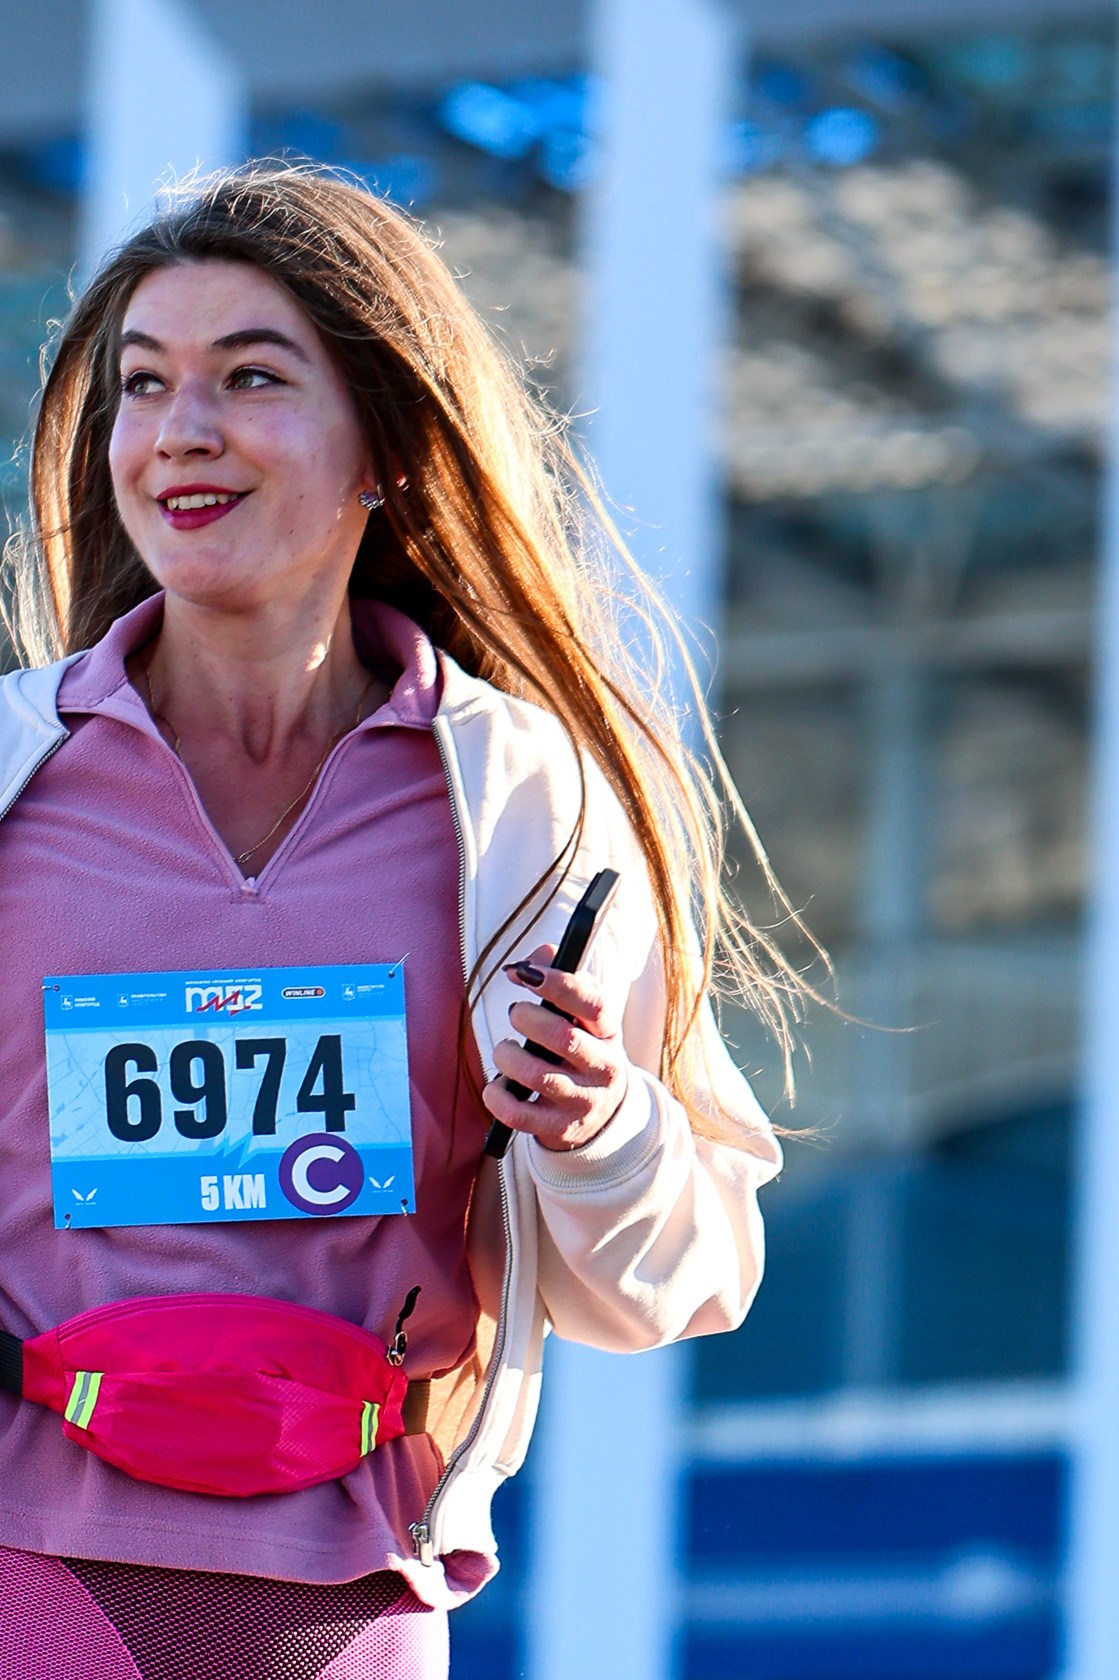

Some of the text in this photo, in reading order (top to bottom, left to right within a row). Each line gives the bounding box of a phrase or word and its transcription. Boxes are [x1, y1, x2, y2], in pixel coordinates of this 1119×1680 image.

[284, 988, 315, 997] WINLINE
[105, 1034, 356, 1142] 6974
[200, 1173, 266, 1211] 5 KM
[291, 1145, 351, 1205] C
